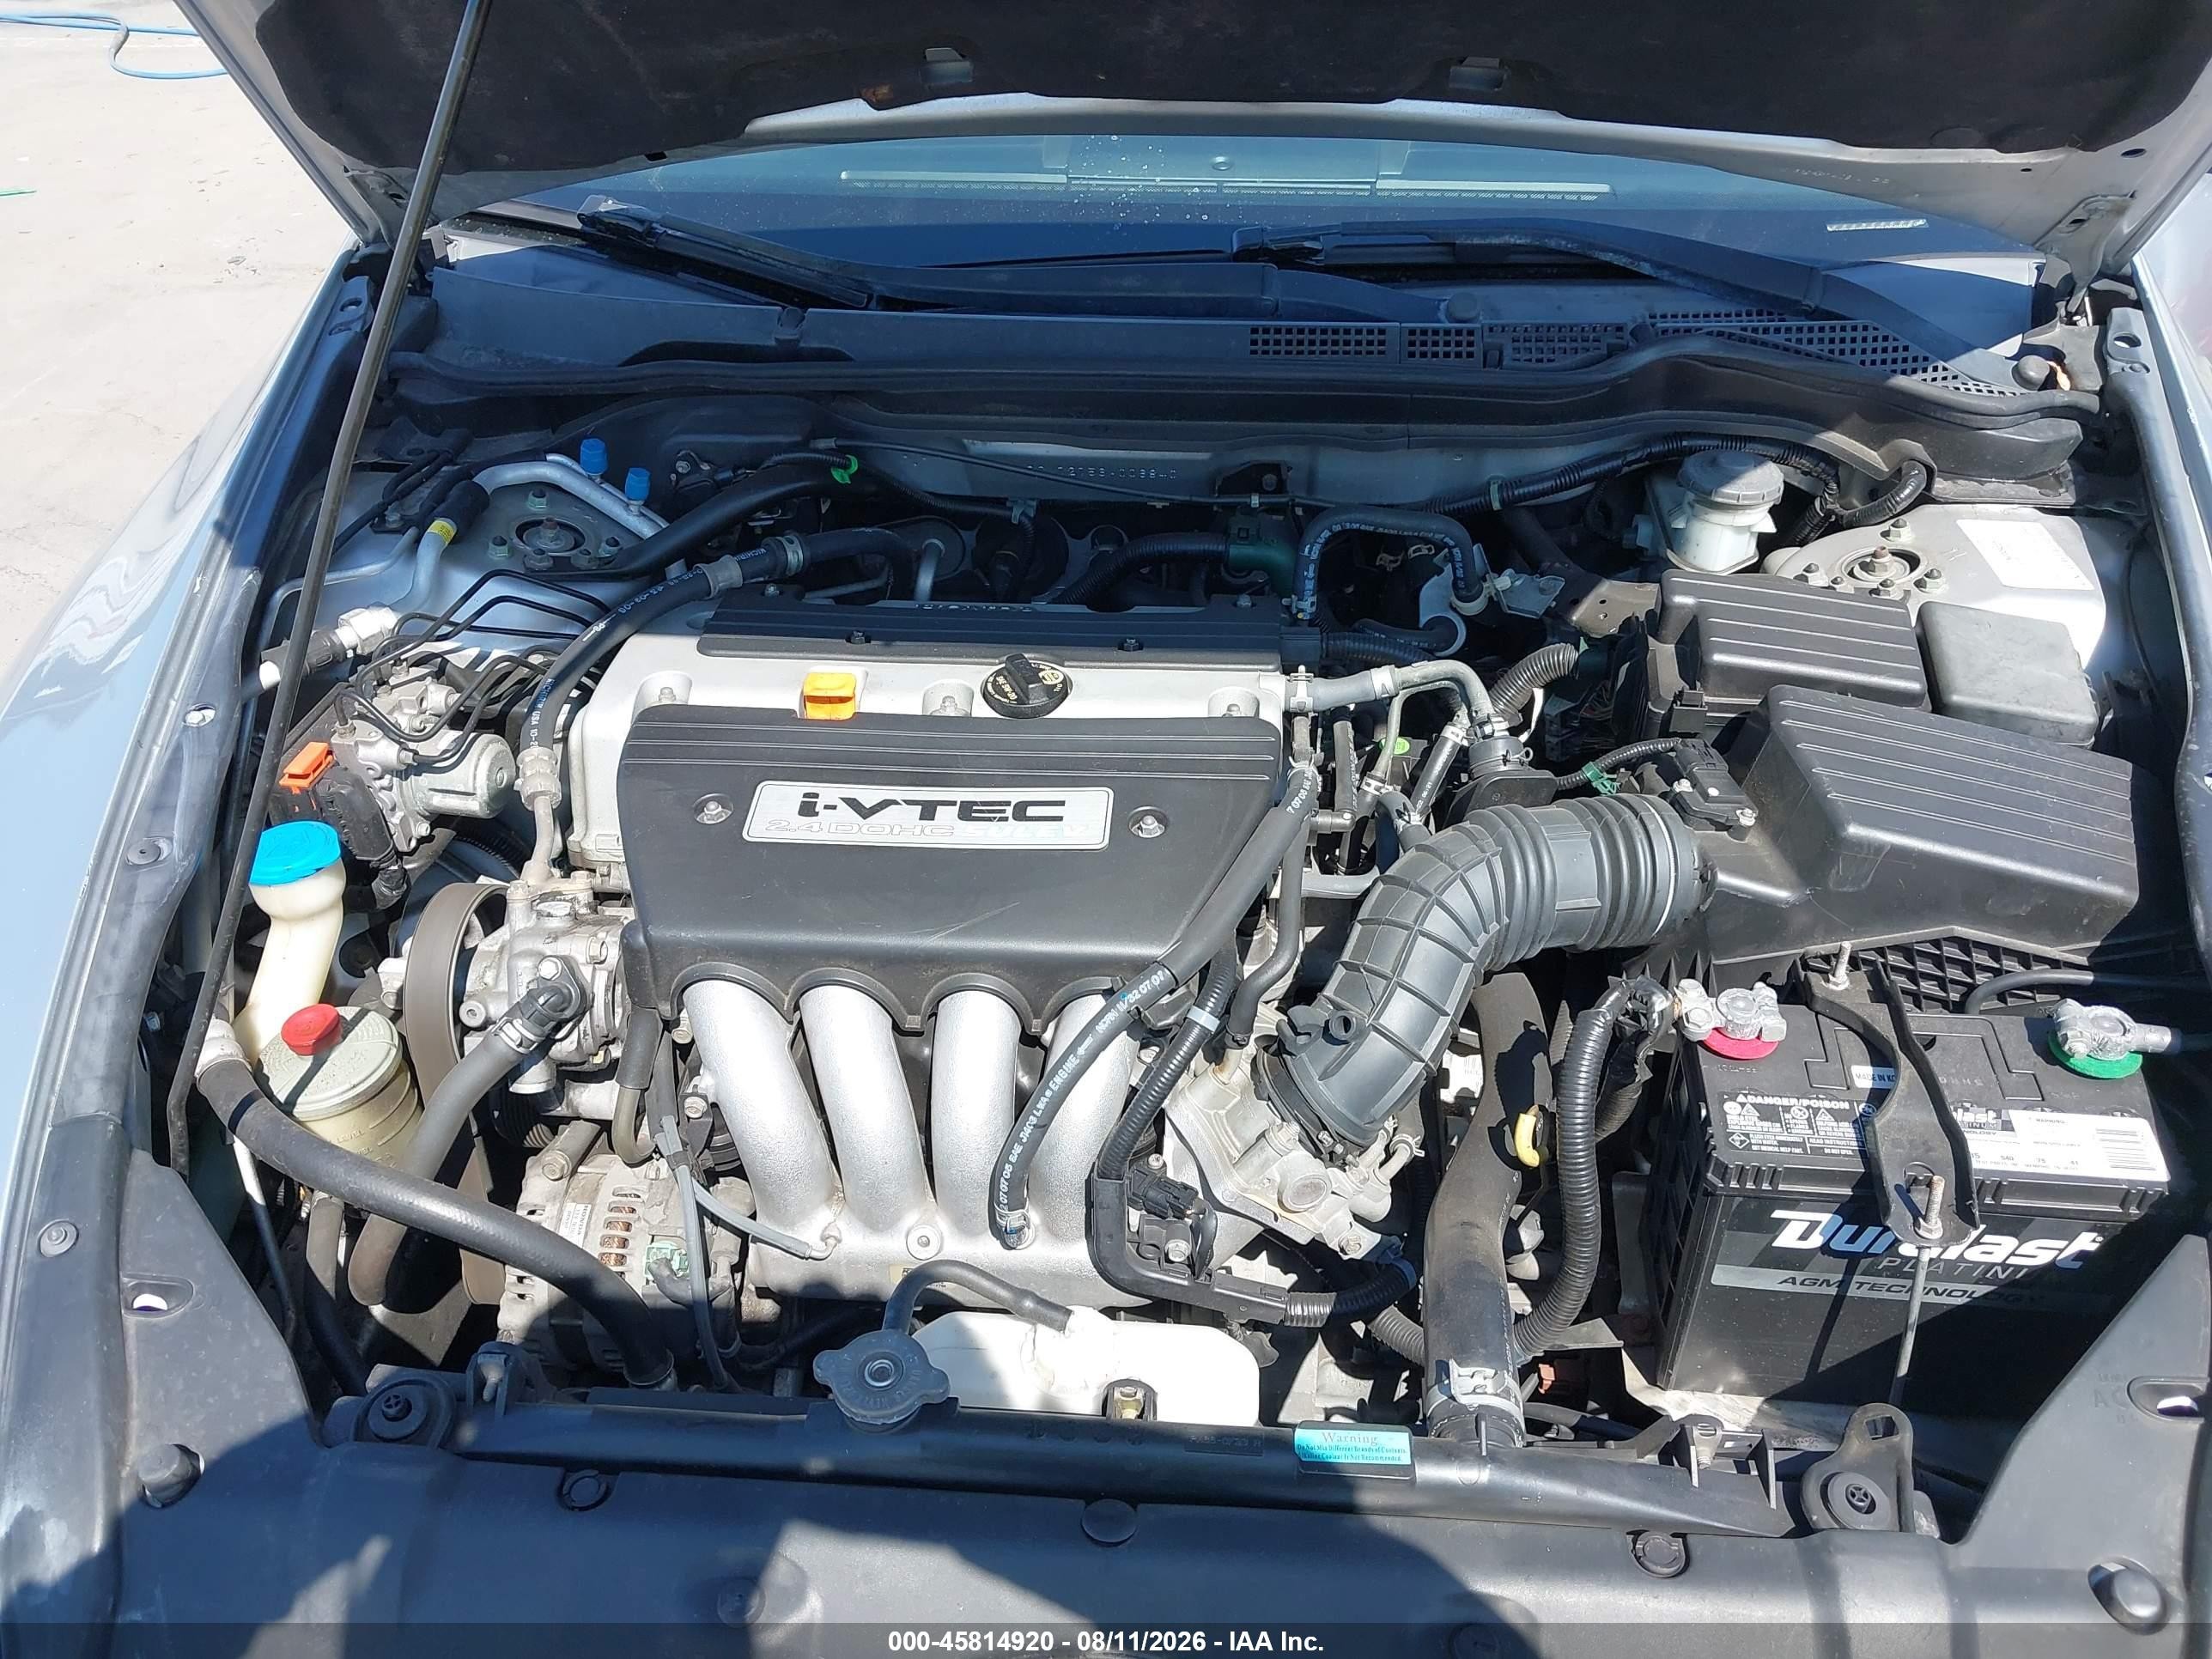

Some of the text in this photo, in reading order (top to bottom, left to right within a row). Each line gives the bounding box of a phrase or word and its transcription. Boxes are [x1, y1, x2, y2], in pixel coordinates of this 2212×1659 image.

[532, 711, 541, 725] USA
[798, 792, 1066, 823] i-VTEC
[765, 818, 823, 833] 2.4
[828, 821, 955, 837] DOHC
[1050, 1053, 1080, 1093] ENGINE
[1747, 1095, 1850, 1110] DANGER/POISON
[1778, 1276, 1845, 1289] AGM
[1322, 1432, 1379, 1445] Warning
